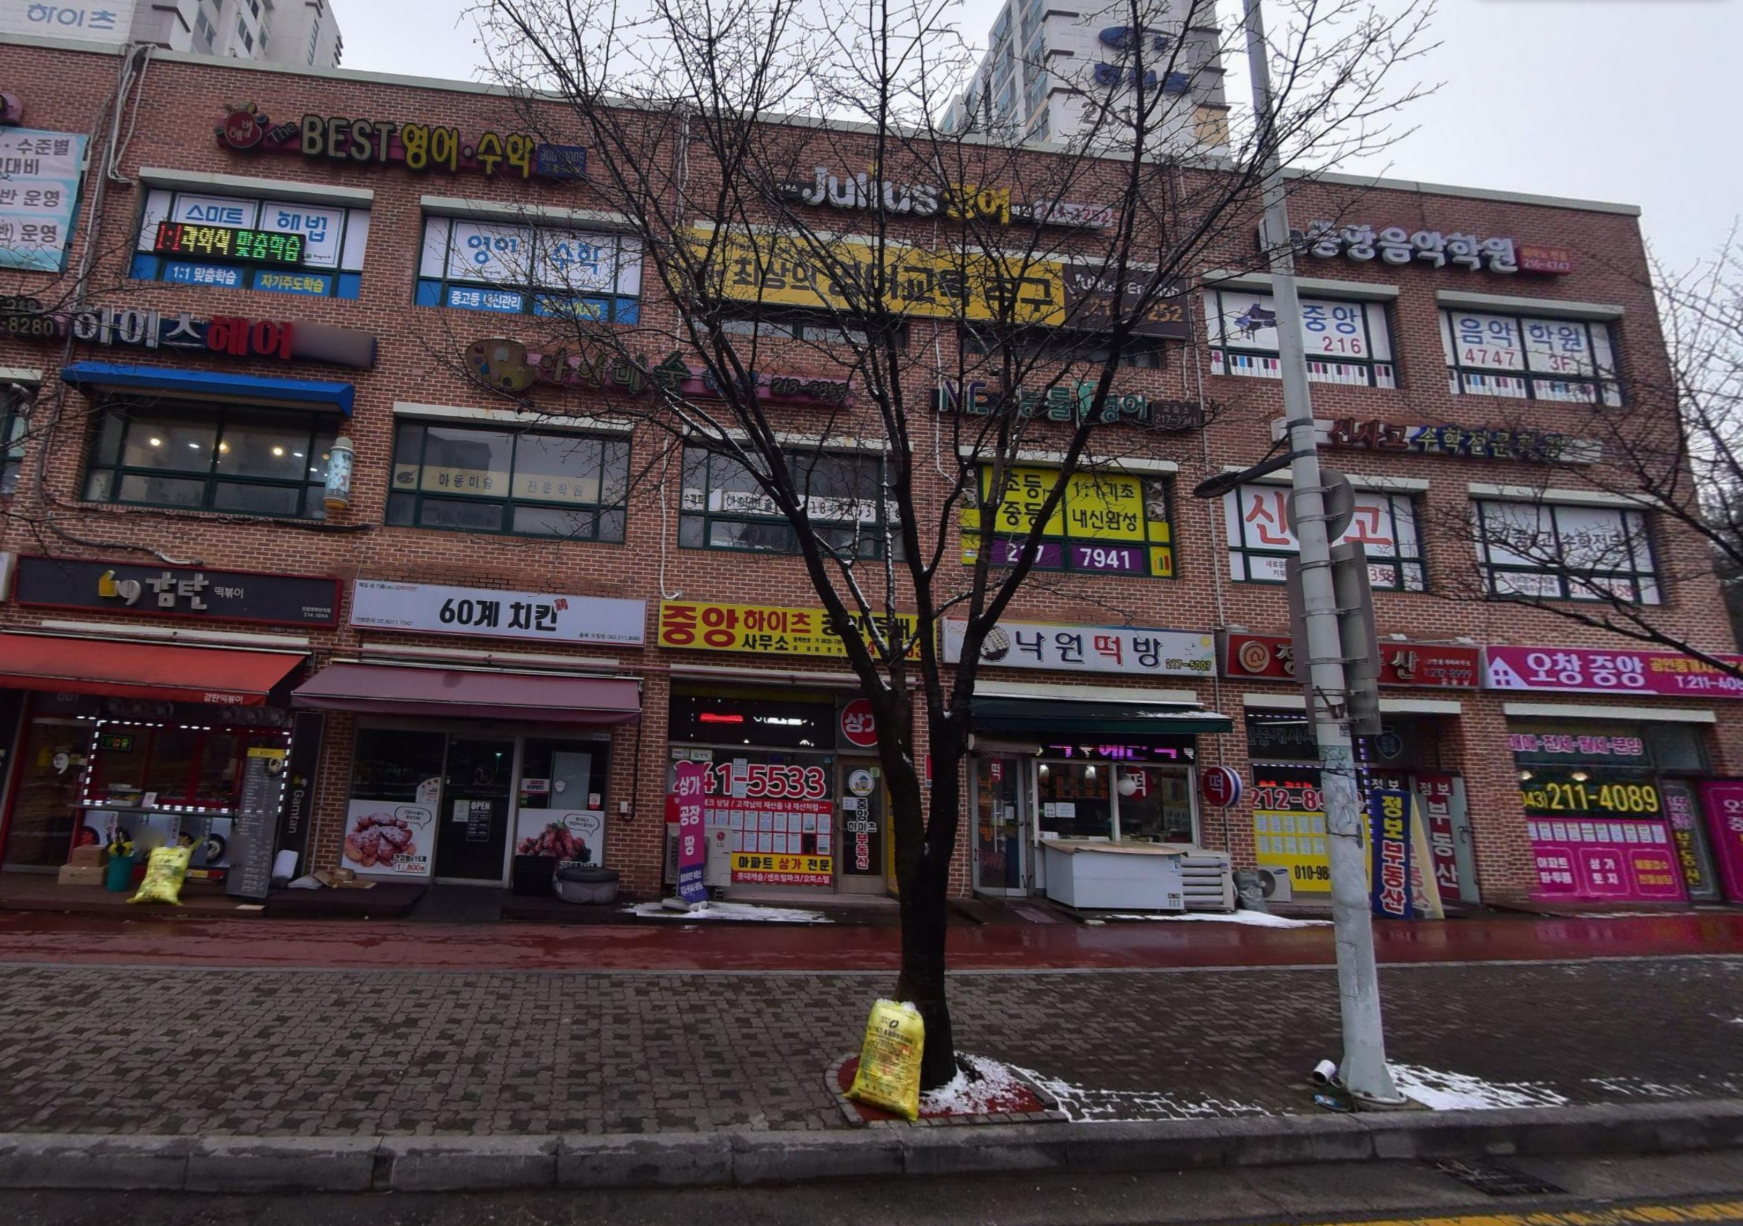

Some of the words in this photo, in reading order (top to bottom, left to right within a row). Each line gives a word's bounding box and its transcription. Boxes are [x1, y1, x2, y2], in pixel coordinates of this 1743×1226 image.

[27, 3, 116, 30] 하이츠
[16, 138, 70, 156] 수준별
[267, 122, 297, 143] The
[302, 114, 395, 162] BEST
[23, 190, 60, 208] 운영
[185, 204, 244, 225] 스마트
[20, 223, 57, 243] 운영
[277, 210, 328, 243] 해법
[235, 231, 301, 262] 맞춤학습
[1308, 219, 1519, 275] 중앙음악학원
[172, 266, 190, 280] 1:1
[194, 267, 237, 285] 맞춤학습
[261, 273, 325, 294] 자기주도학습
[451, 291, 480, 307] 중고등
[483, 293, 521, 310] 내신관리
[1303, 304, 1358, 335] 중앙
[1322, 336, 1362, 354] 216
[1460, 318, 1513, 348] 음악
[1529, 323, 1582, 353] 학원
[1465, 348, 1515, 367] 4747
[1551, 355, 1572, 371] 3F
[1328, 417, 1409, 450] 신사고
[438, 473, 493, 491] 아동미술
[527, 480, 585, 498] 전문학원
[1072, 509, 1137, 532] 내신완성
[1245, 491, 1393, 546] 신고
[1008, 543, 1043, 563] 27
[1080, 548, 1131, 569] 7941
[145, 572, 209, 610] 감탄
[214, 586, 244, 599] 떡볶이
[439, 598, 500, 628] 60계
[508, 602, 558, 632] 치킨
[662, 604, 739, 648] 중앙
[743, 609, 812, 634] 하이츠
[741, 634, 789, 651] 사무소
[1527, 652, 1583, 685] 오창
[1588, 655, 1646, 687] 중앙
[673, 759, 826, 798] 41-5533
[679, 776, 701, 796] 상가
[1208, 773, 1224, 799] 떡
[1418, 782, 1451, 796] 정보
[287, 789, 305, 835] Gamtan
[470, 801, 491, 810] OPEN
[680, 805, 701, 827] 공장
[716, 799, 730, 808] 상담
[736, 800, 762, 809] 고객님의
[763, 801, 784, 810] 재산을
[1381, 795, 1404, 840] 정보
[856, 832, 870, 870] 부동산
[1428, 801, 1459, 888] 부동산
[739, 856, 773, 869] 아파트
[779, 857, 802, 870] 상가
[807, 859, 830, 871] 전문
[1536, 856, 1570, 869] 아파트
[1589, 858, 1616, 871] 상가
[1380, 839, 1406, 916] 부동산
[1592, 872, 1619, 885] 토지
